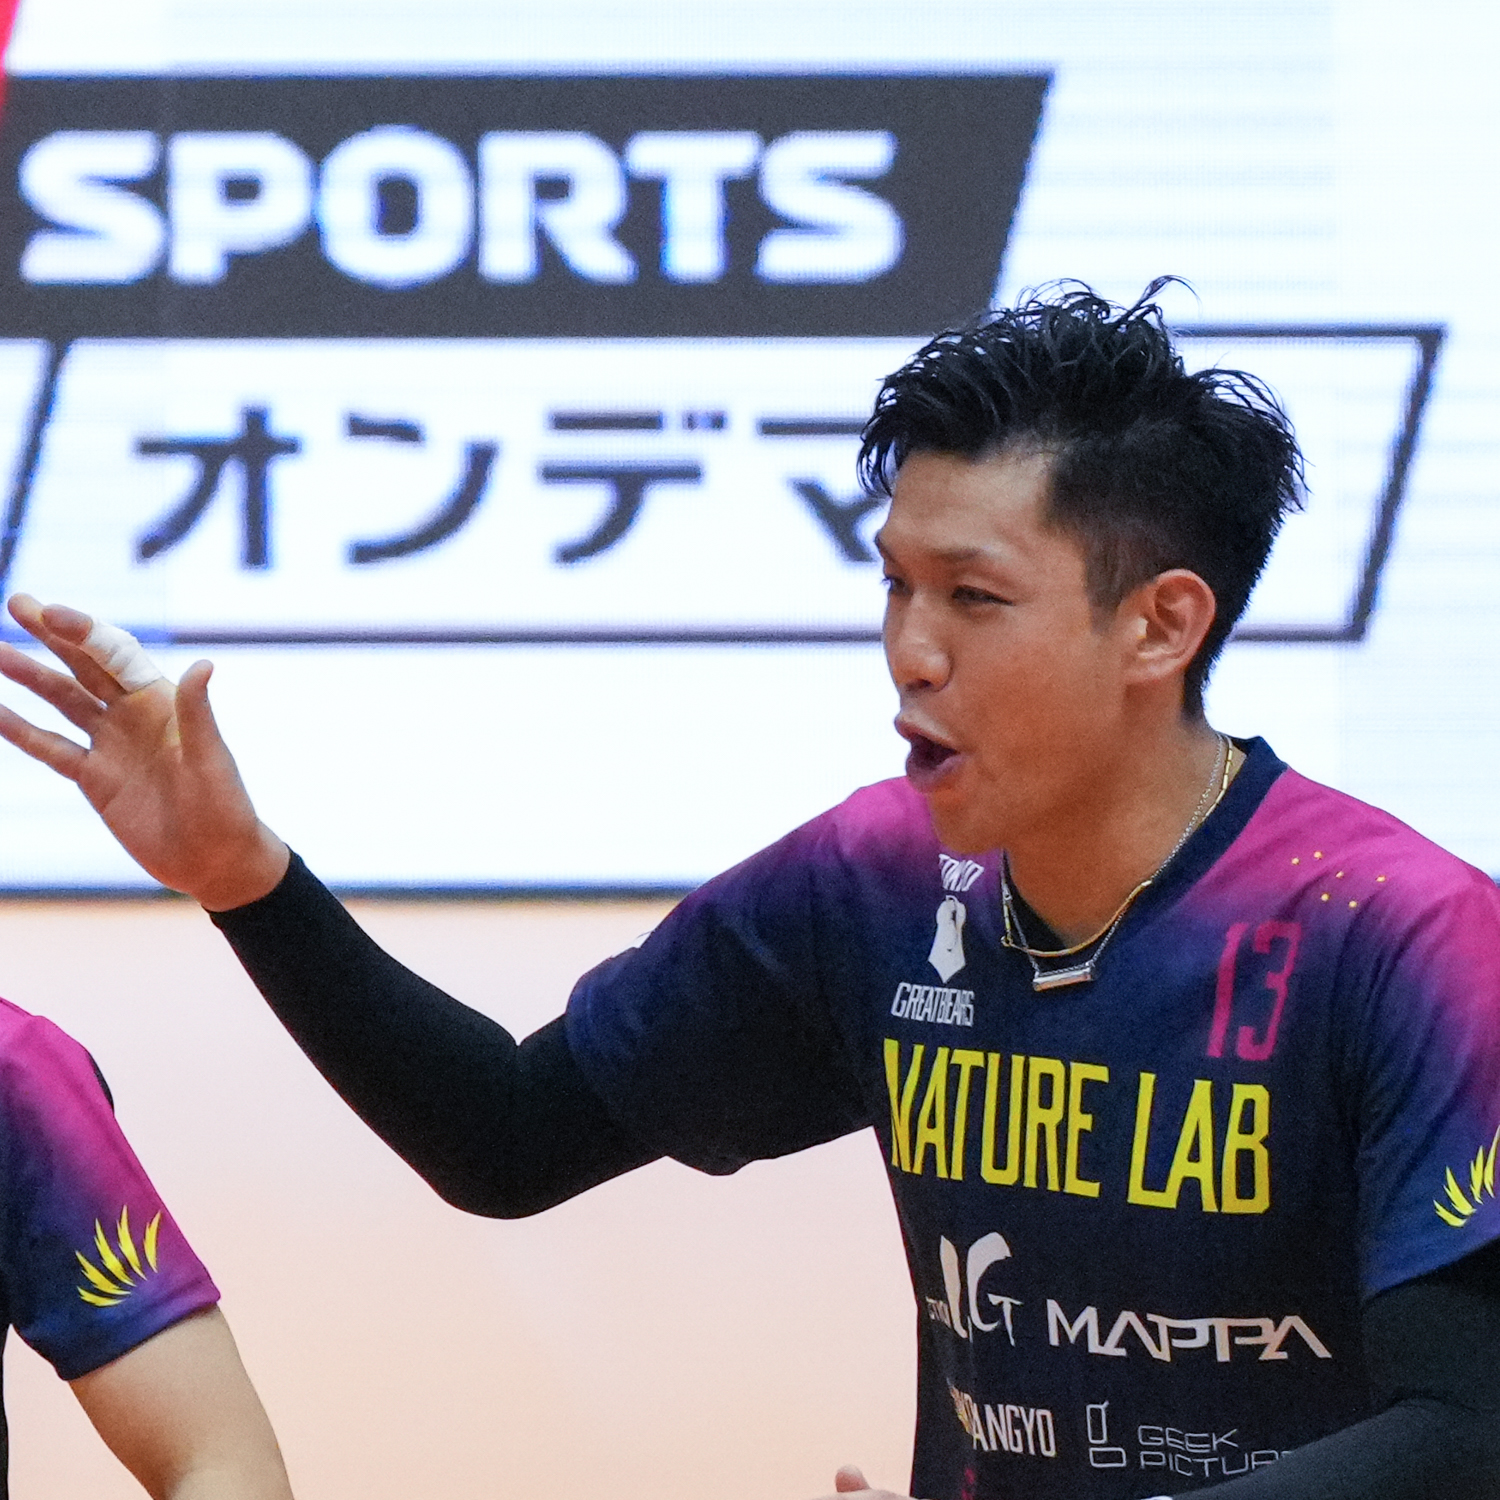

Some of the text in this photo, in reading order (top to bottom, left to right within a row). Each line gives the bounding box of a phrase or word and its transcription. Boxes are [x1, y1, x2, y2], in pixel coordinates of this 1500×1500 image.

[18, 126, 905, 288] SPORTS
[135, 404, 882, 567] オンデマ
[891, 982, 975, 1027] GREATBEARS
[1206, 922, 1301, 1061] 13
[884, 1038, 1270, 1214] NATURE LAB
[1047, 1299, 1332, 1362] MAPPA
[1138, 1425, 1239, 1453] GEEK
[1140, 1449, 1291, 1478] PICTUR
